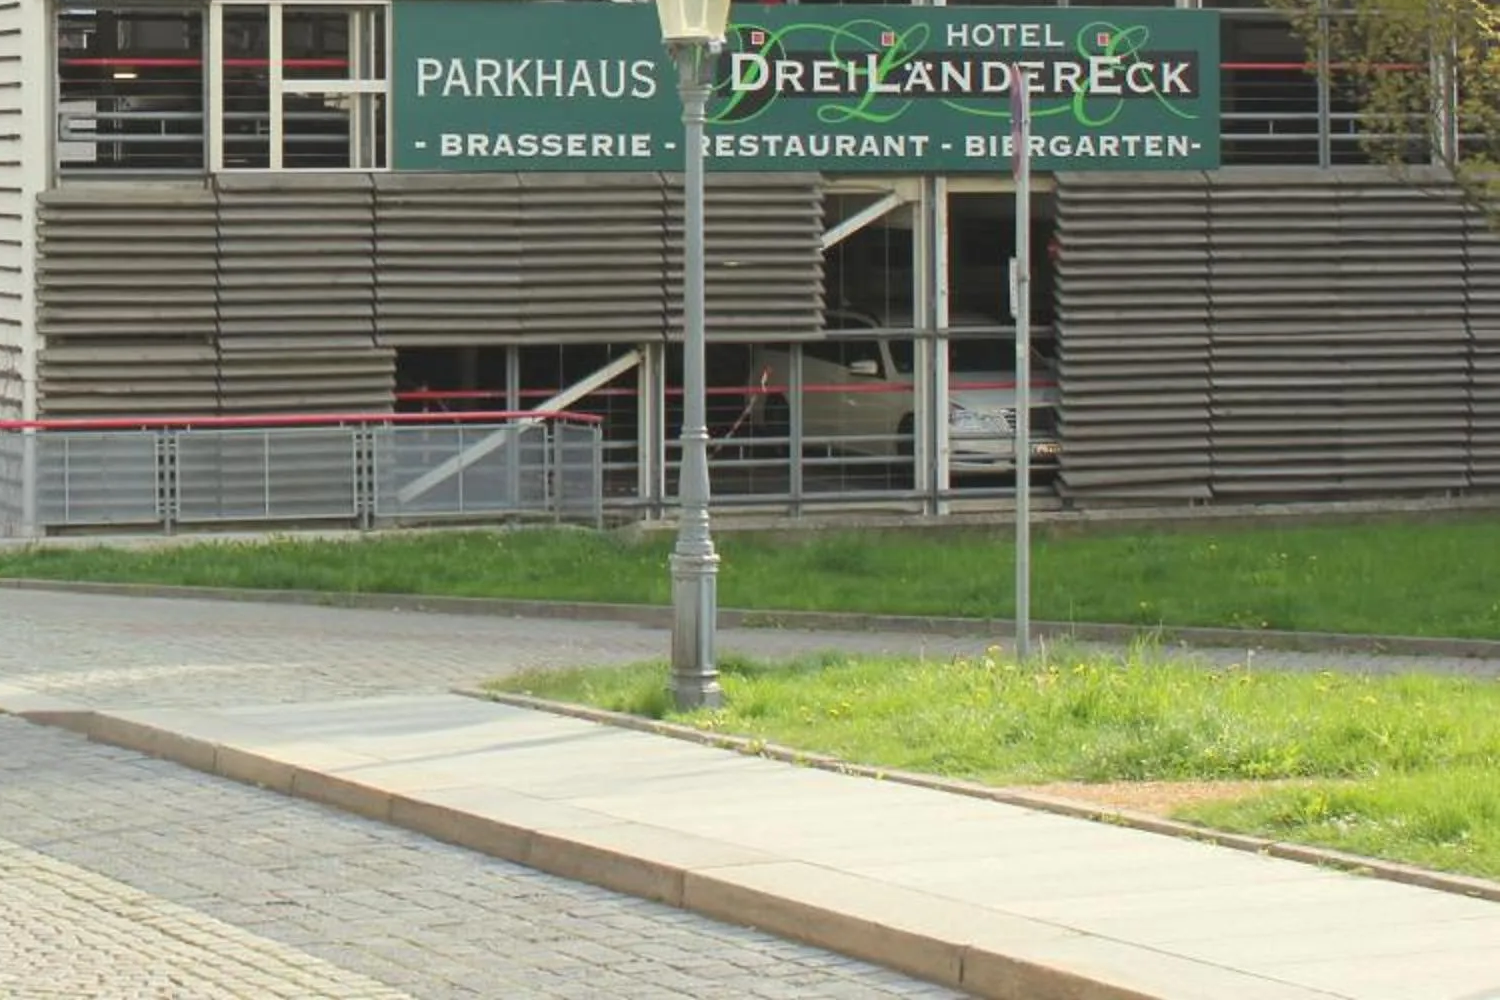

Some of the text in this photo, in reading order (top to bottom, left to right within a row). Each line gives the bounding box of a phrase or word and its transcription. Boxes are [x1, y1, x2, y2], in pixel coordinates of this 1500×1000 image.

[947, 23, 1065, 47] HOTEL
[416, 58, 657, 98] PARKHAUS
[440, 133, 651, 157] BRASSERIE
